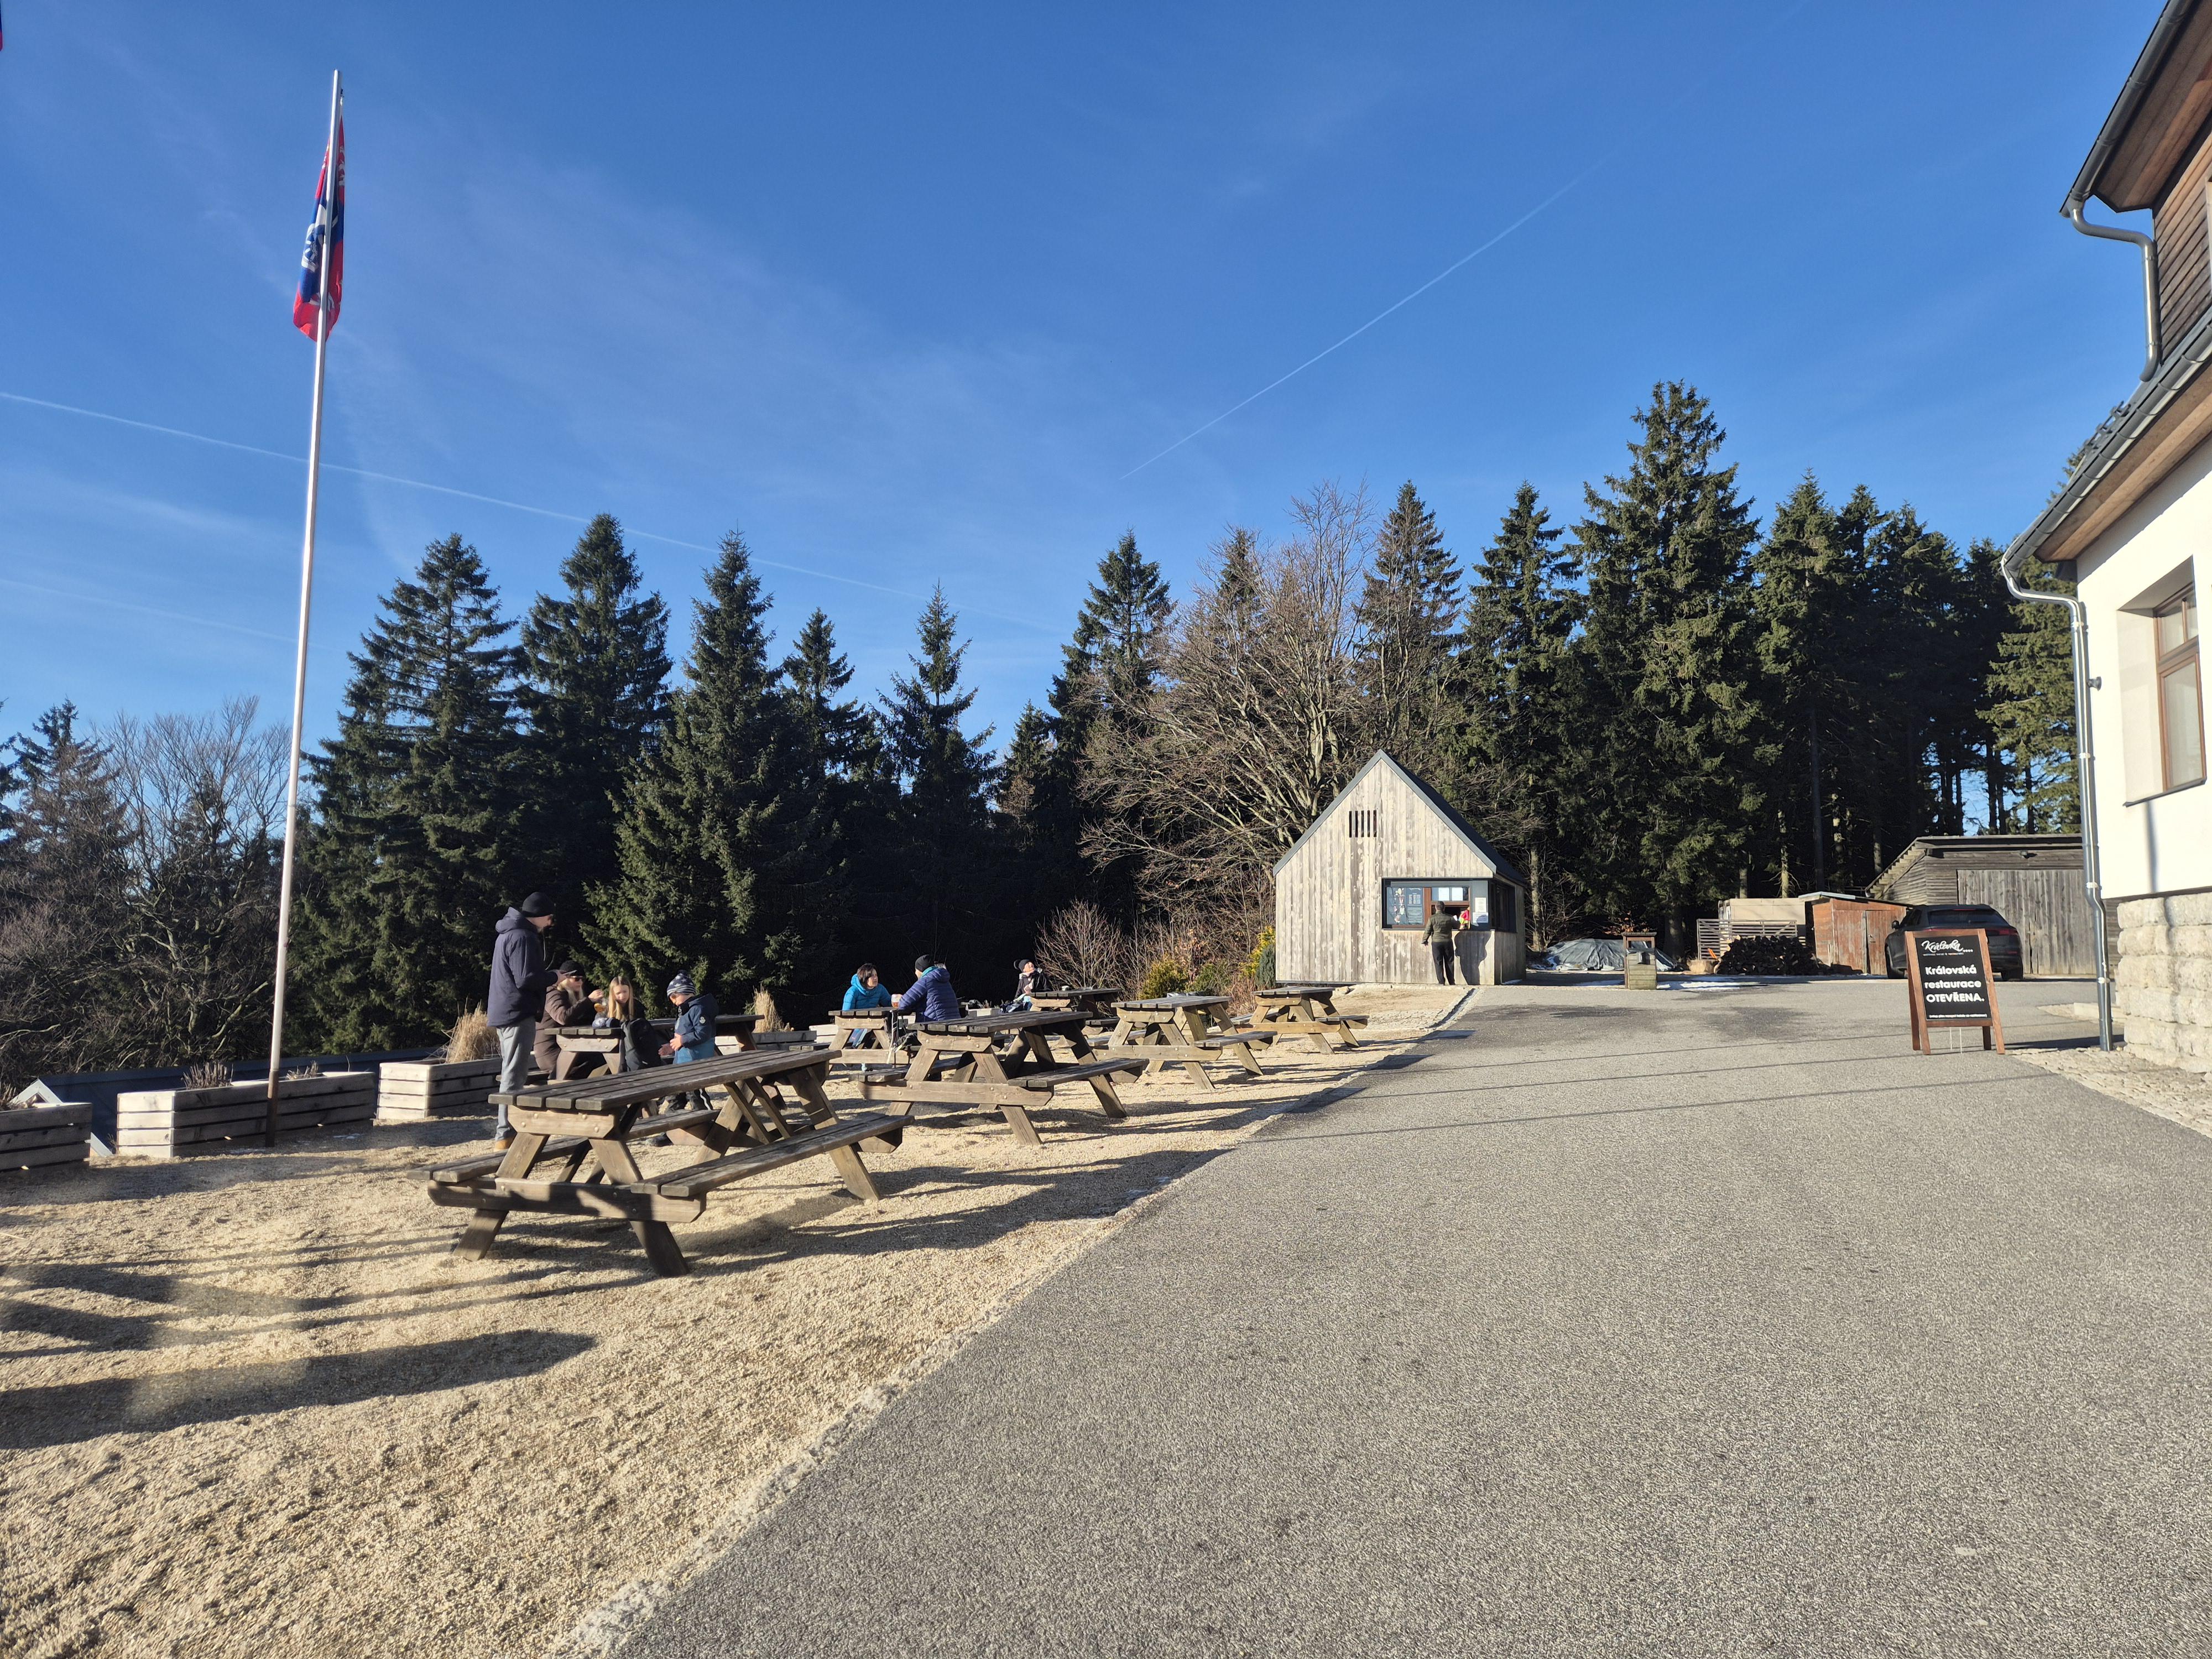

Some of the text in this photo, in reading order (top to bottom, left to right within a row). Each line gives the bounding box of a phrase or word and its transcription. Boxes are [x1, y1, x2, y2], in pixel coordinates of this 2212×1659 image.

[1925, 964, 1977, 975] Královská
[1924, 980, 1981, 989] restaurace
[1926, 992, 1985, 1003] OTEVŘENA.
